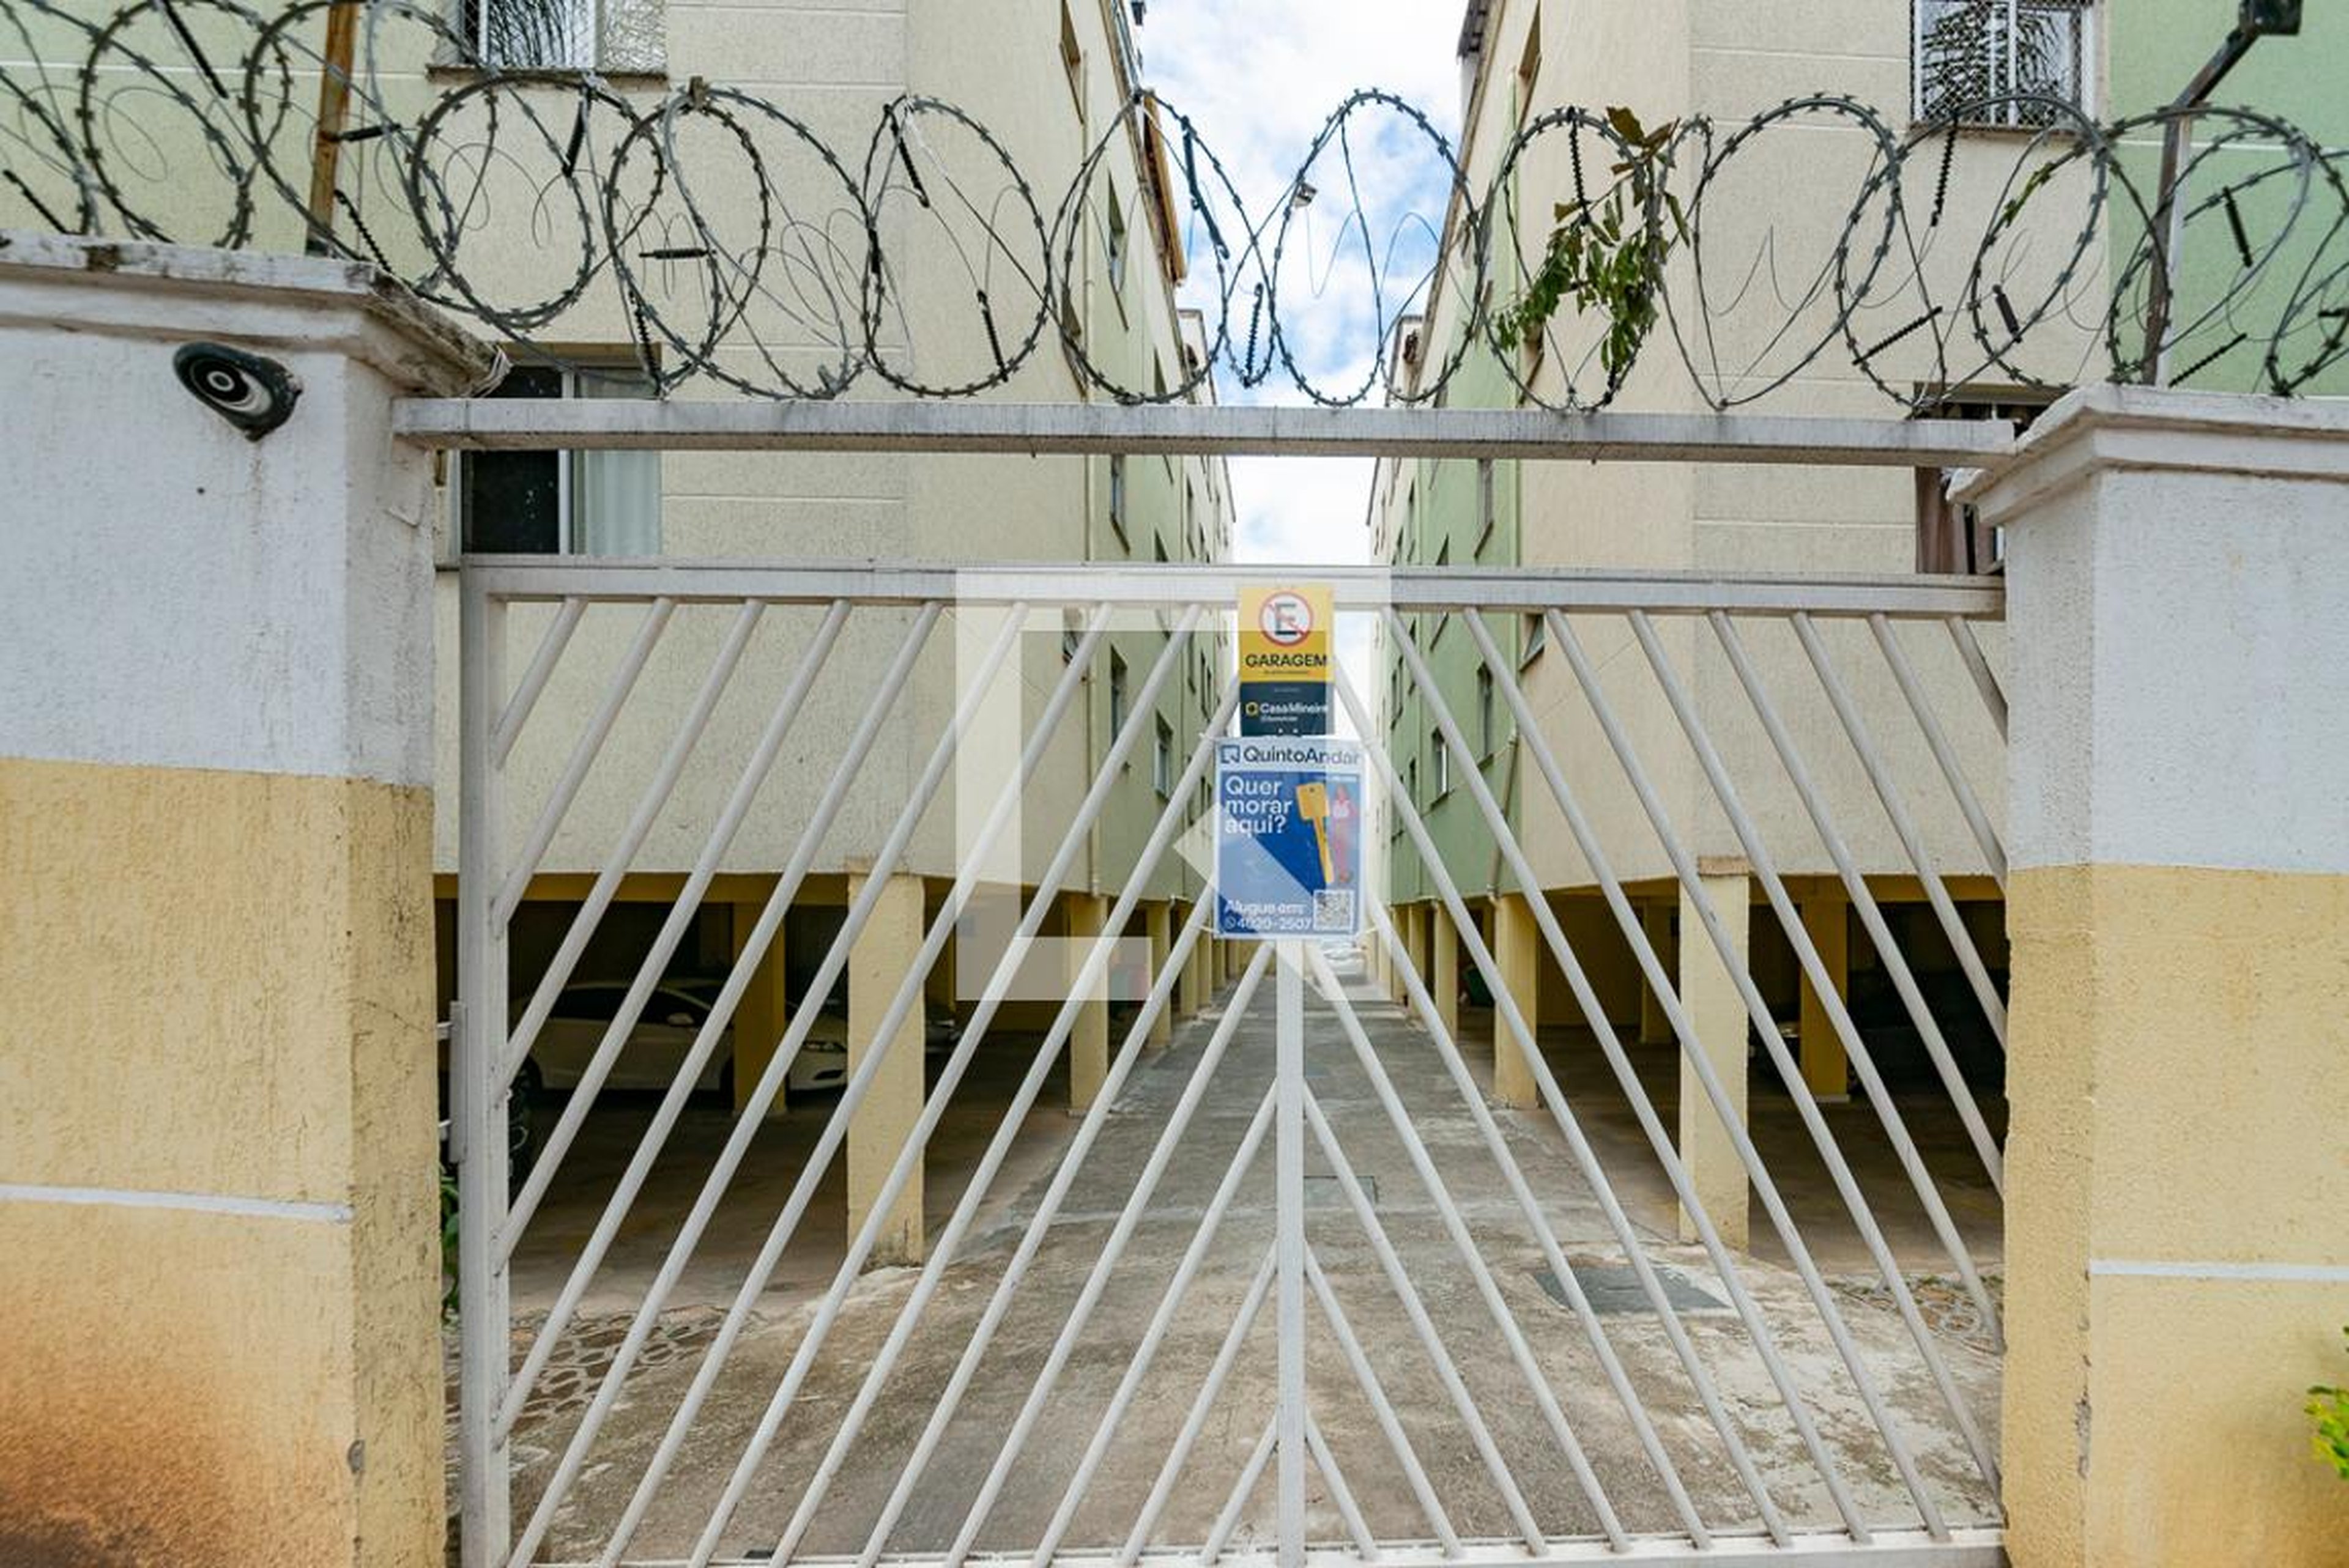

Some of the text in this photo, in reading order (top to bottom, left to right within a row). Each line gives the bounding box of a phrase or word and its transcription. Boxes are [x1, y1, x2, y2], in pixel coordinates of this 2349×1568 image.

[1245, 653, 1327, 667] GARAGEM
[1243, 744, 1359, 764] QuintoAndar
[1225, 775, 1282, 795] Quer
[1225, 799, 1293, 815] morar
[1225, 815, 1286, 838] aqui?
